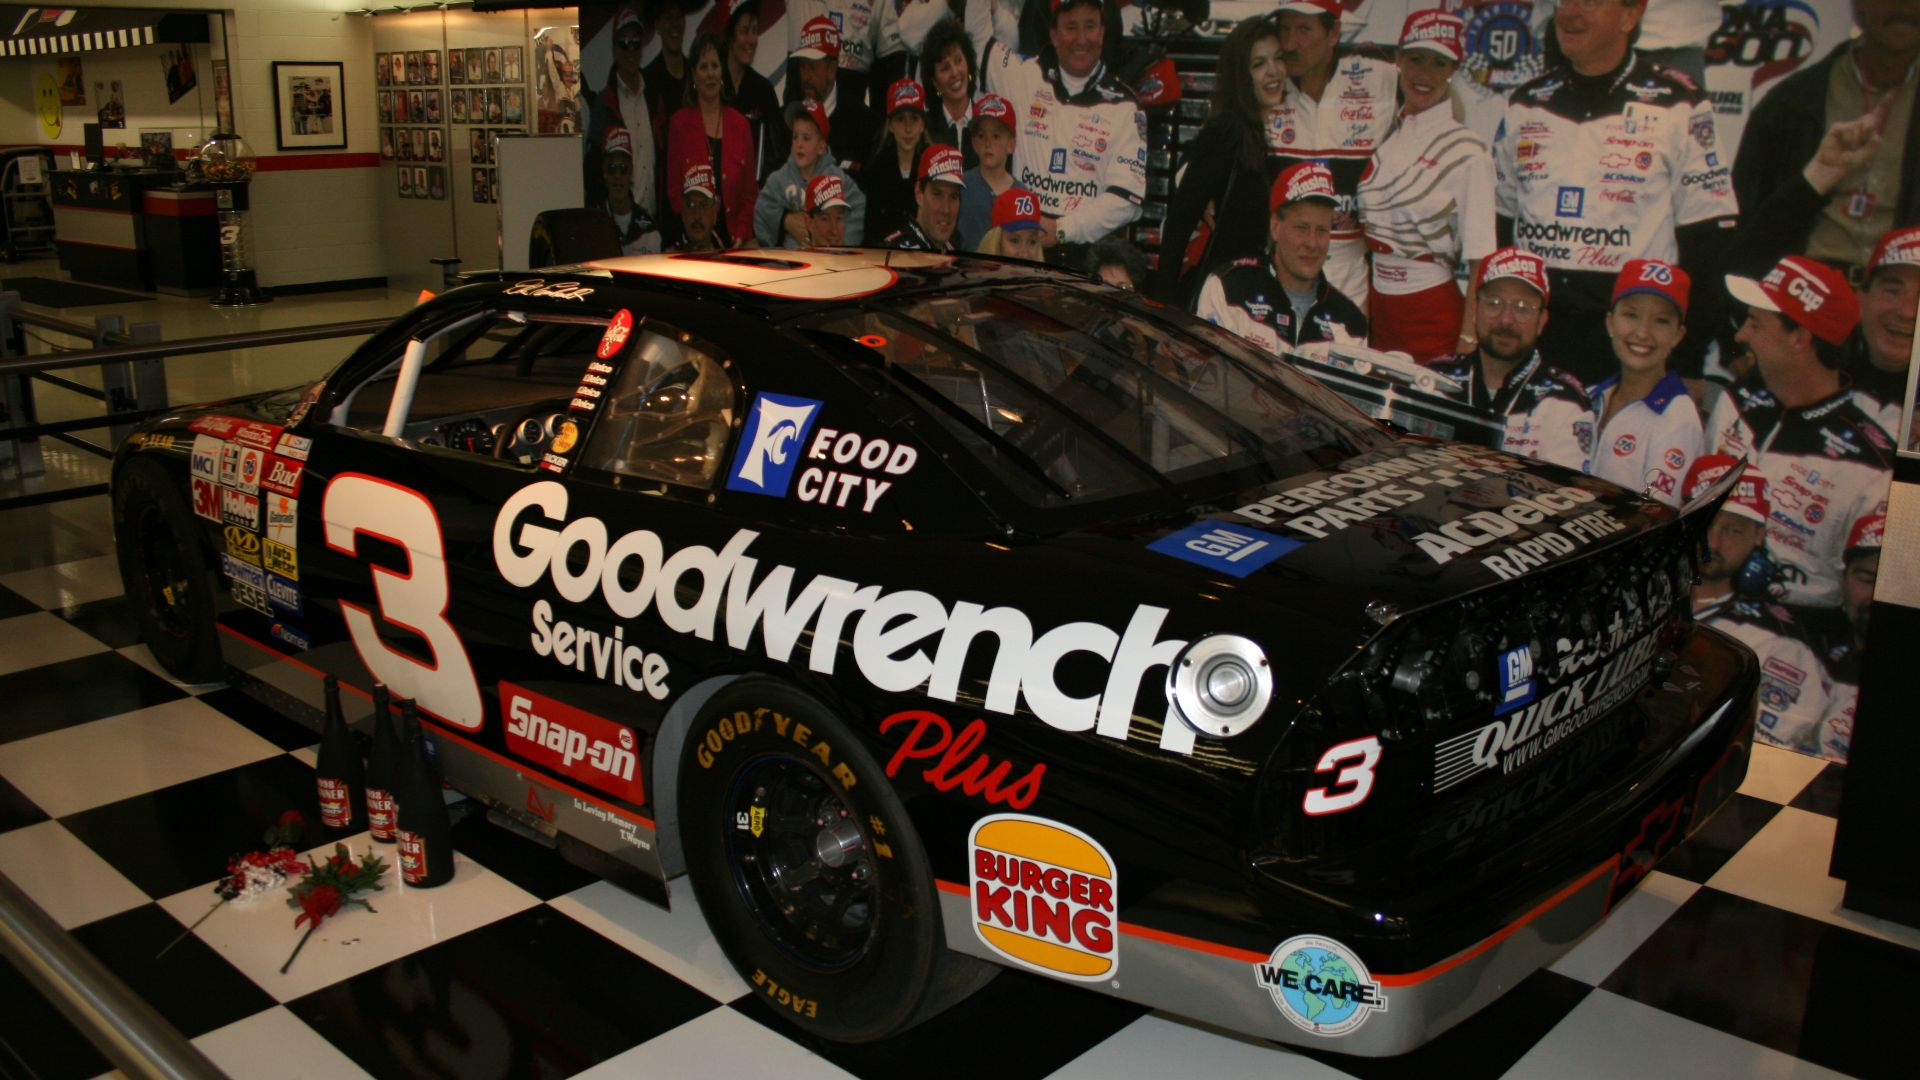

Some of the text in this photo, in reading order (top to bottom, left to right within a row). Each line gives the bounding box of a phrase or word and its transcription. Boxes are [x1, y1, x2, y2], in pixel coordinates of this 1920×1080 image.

[1489, 29, 1518, 61] 50
[1703, 32, 1803, 67] 500
[1016, 196, 1034, 216] 76
[1022, 166, 1098, 198] Goodwrench
[220, 225, 240, 245] 3
[1517, 220, 1631, 247] Goodwrench
[1528, 242, 1621, 268] Service Plus
[1640, 263, 1674, 287] 76
[1786, 277, 1825, 313] Cup
[193, 454, 214, 475] MCI
[268, 460, 303, 487] Bud
[808, 427, 919, 476] FOOD
[194, 479, 222, 521] 3M
[797, 466, 894, 514] CITY
[1284, 484, 1425, 540] PARTS
[1184, 528, 1255, 557] GM
[1410, 485, 1598, 565] ACDelco
[1479, 508, 1629, 580] RAPID FIRE
[321, 470, 486, 733] 3
[493, 480, 1200, 756] Goodwrench
[530, 599, 671, 701] Service
[1507, 644, 1534, 687] GM
[1471, 668, 1598, 769] QUICK
[1588, 621, 1665, 701] LUBE
[507, 694, 637, 782] Snap-on
[696, 707, 858, 791] GOODYEAR
[879, 708, 1047, 810] Plus
[1301, 734, 1385, 817] 3
[975, 848, 1114, 913] BURGER
[976, 880, 1114, 954] KING
[751, 967, 820, 1019] EAGLE
[1260, 964, 1382, 1006] WE CARE.
